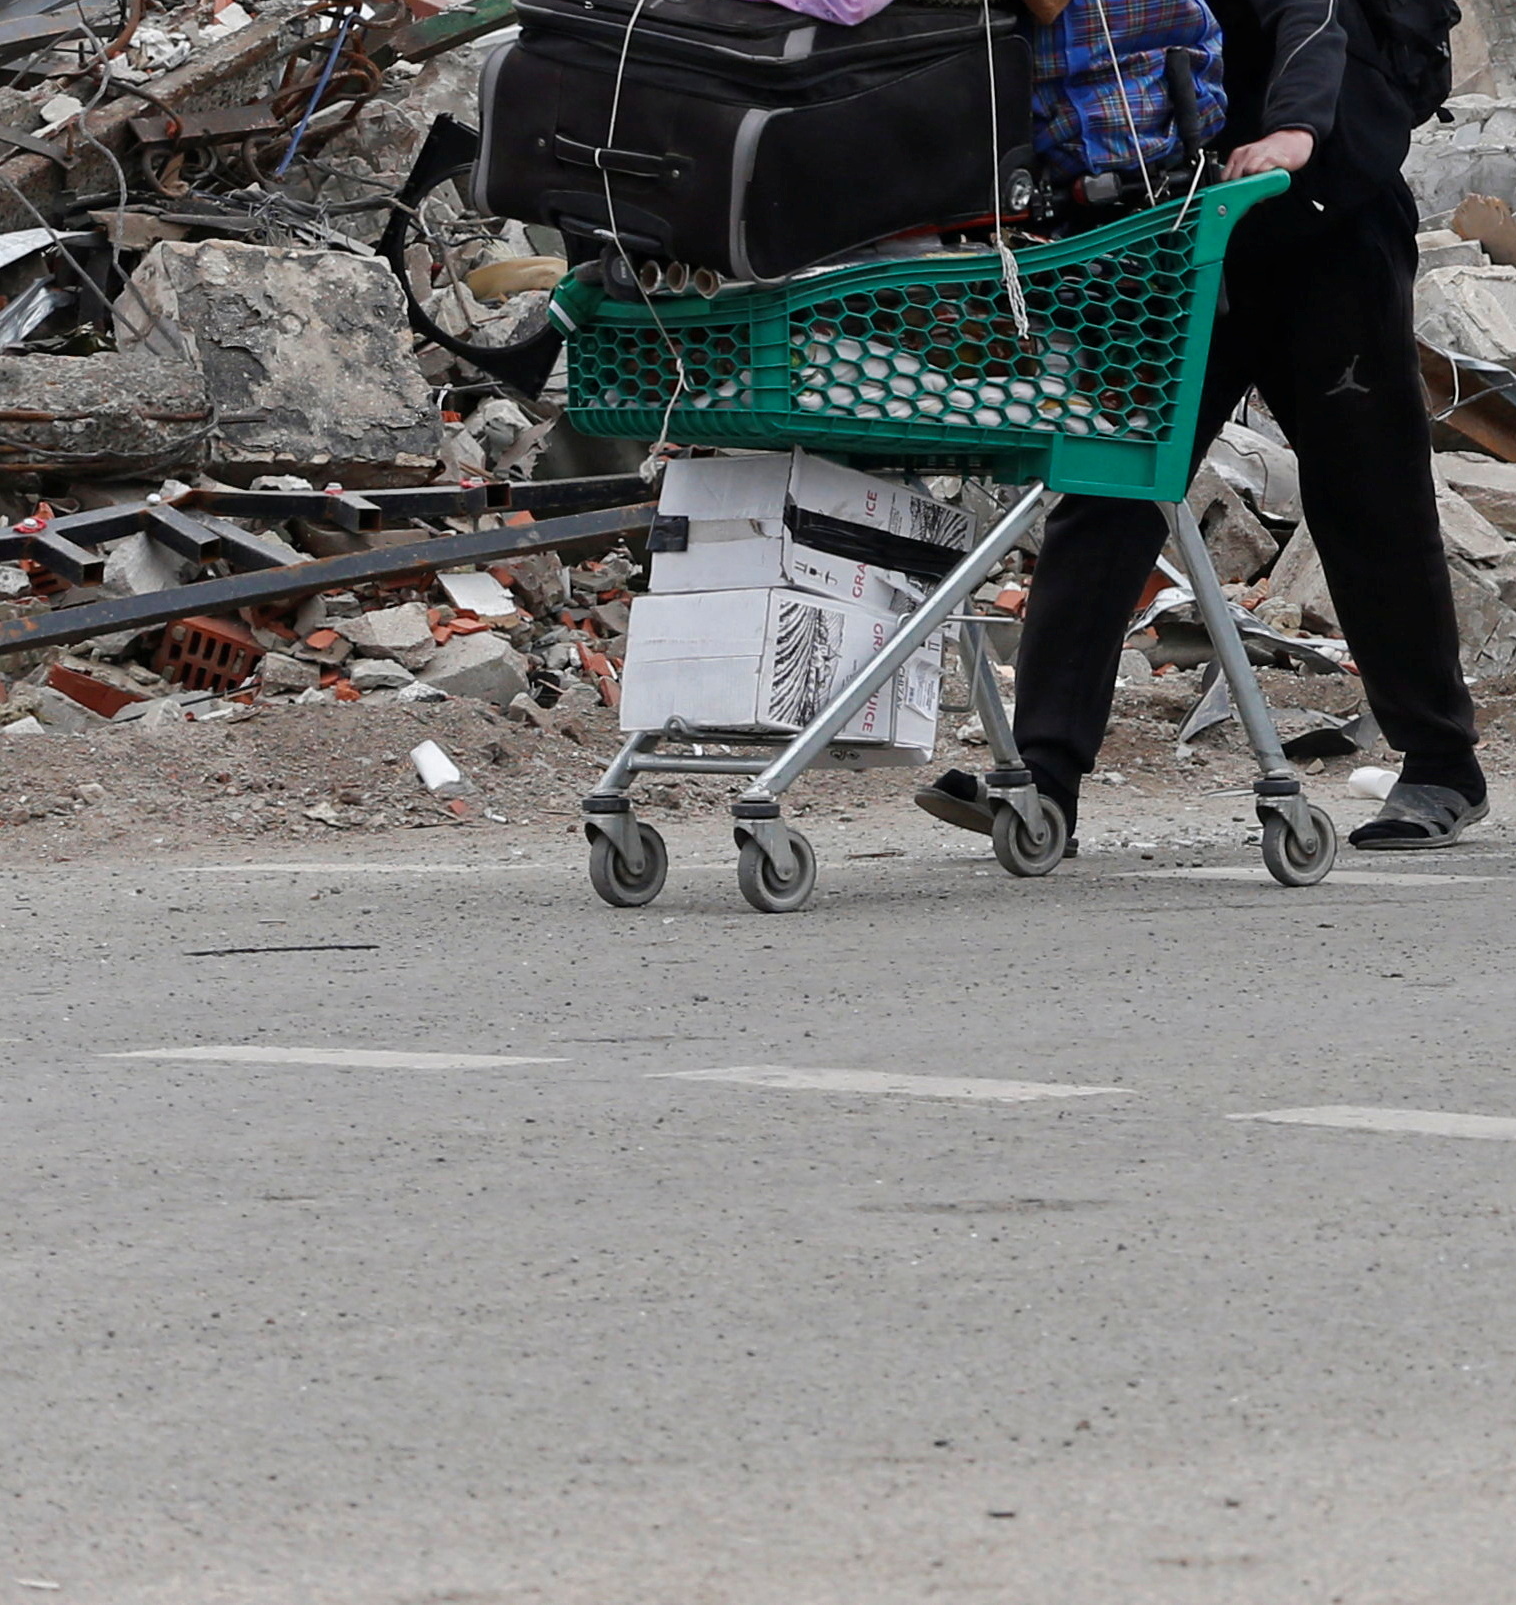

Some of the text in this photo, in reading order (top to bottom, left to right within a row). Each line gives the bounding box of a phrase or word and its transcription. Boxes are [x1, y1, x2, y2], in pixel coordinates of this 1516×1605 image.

[852, 489, 878, 599] GRA ICE
[861, 691, 880, 733] UICE
